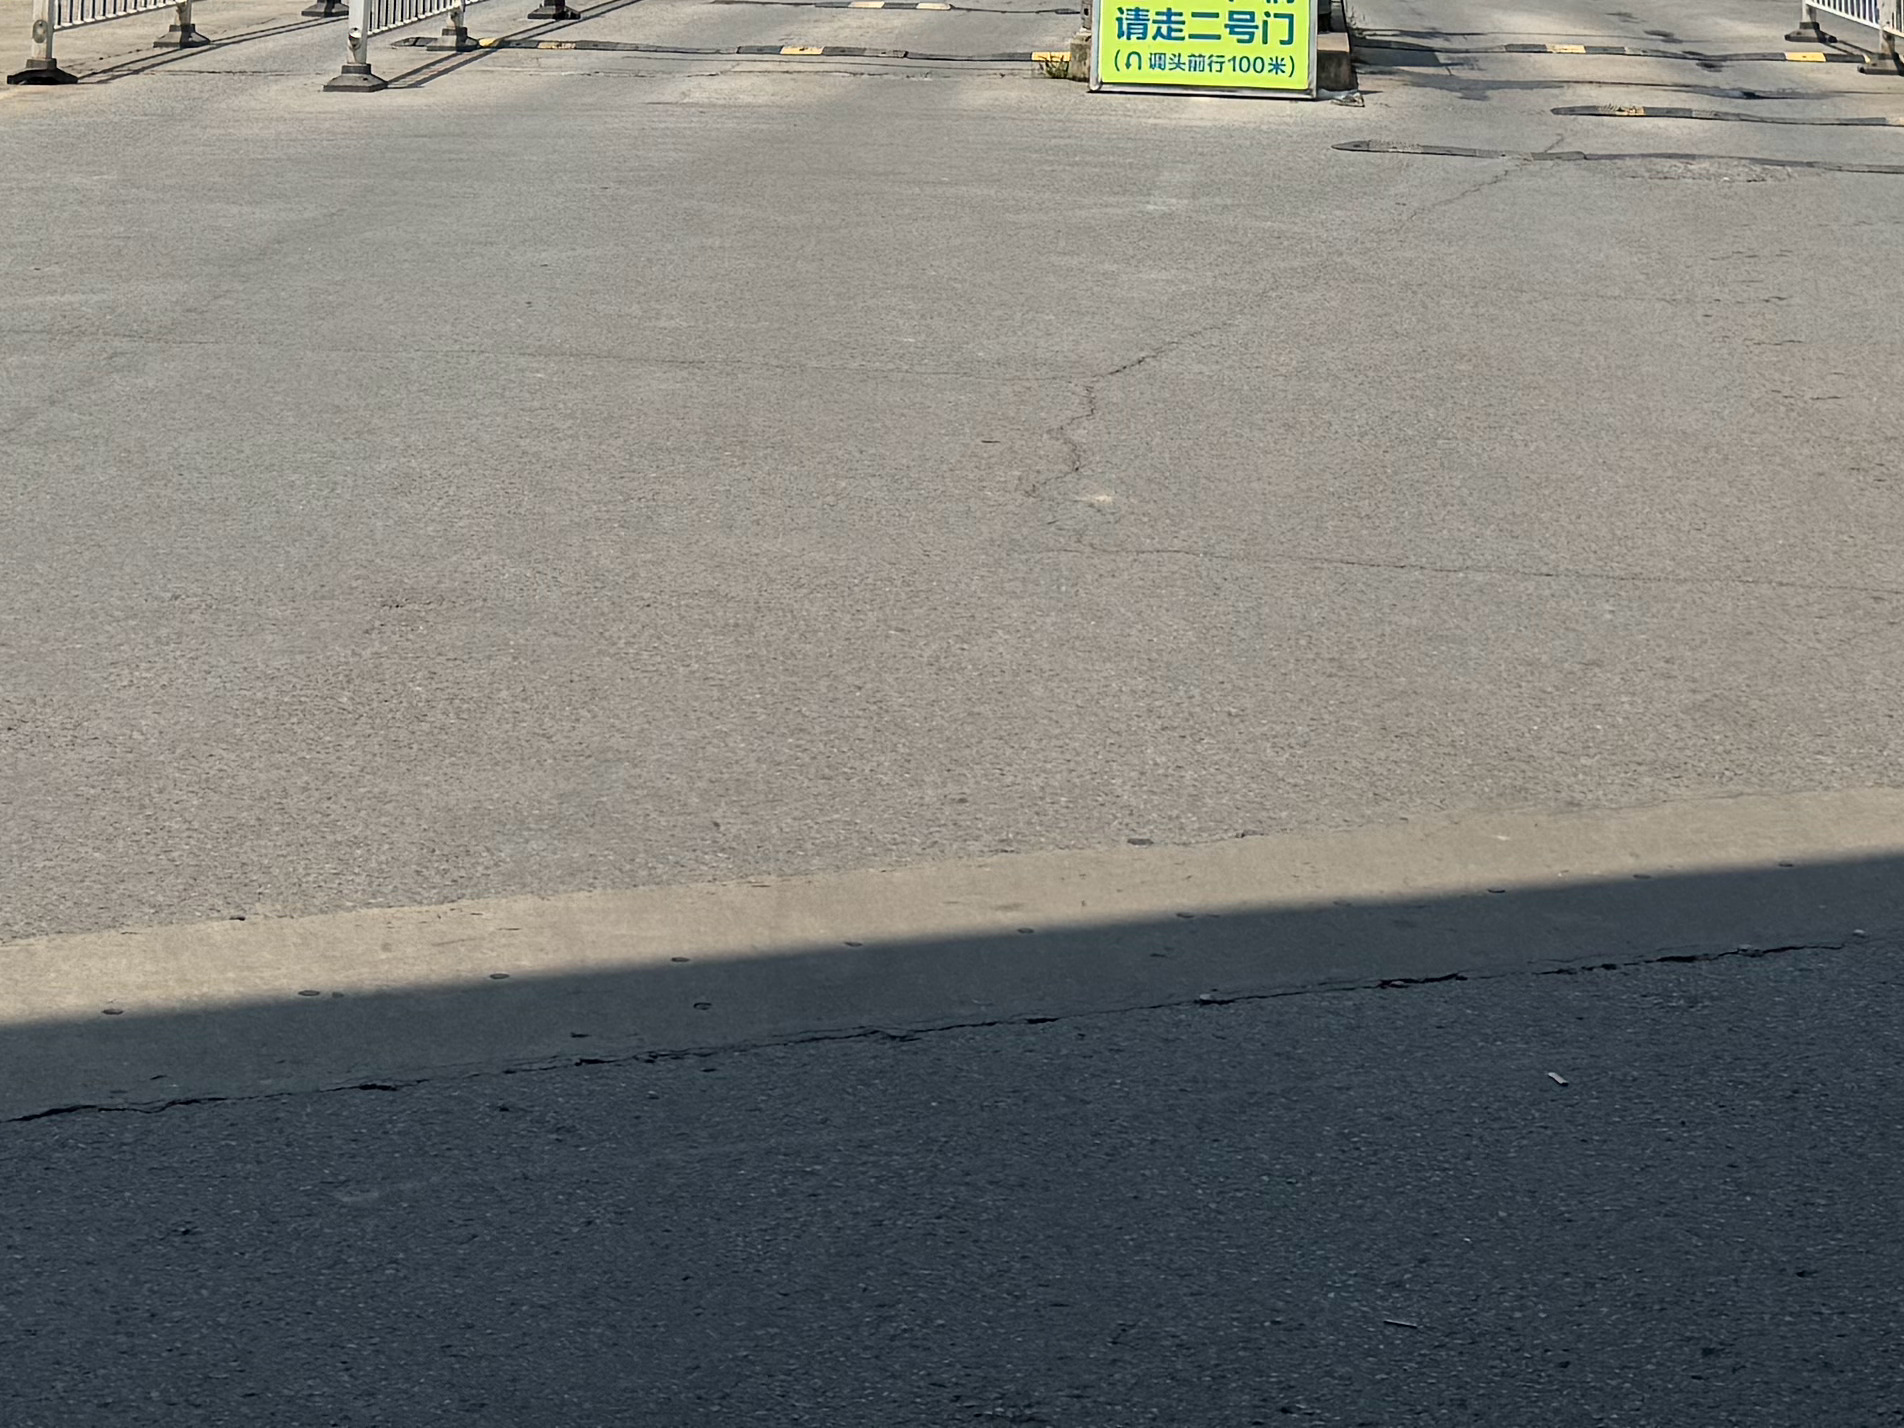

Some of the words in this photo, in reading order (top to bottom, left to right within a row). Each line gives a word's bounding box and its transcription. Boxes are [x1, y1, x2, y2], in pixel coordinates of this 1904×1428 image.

[1115, 6, 1295, 46] 请走二号门
